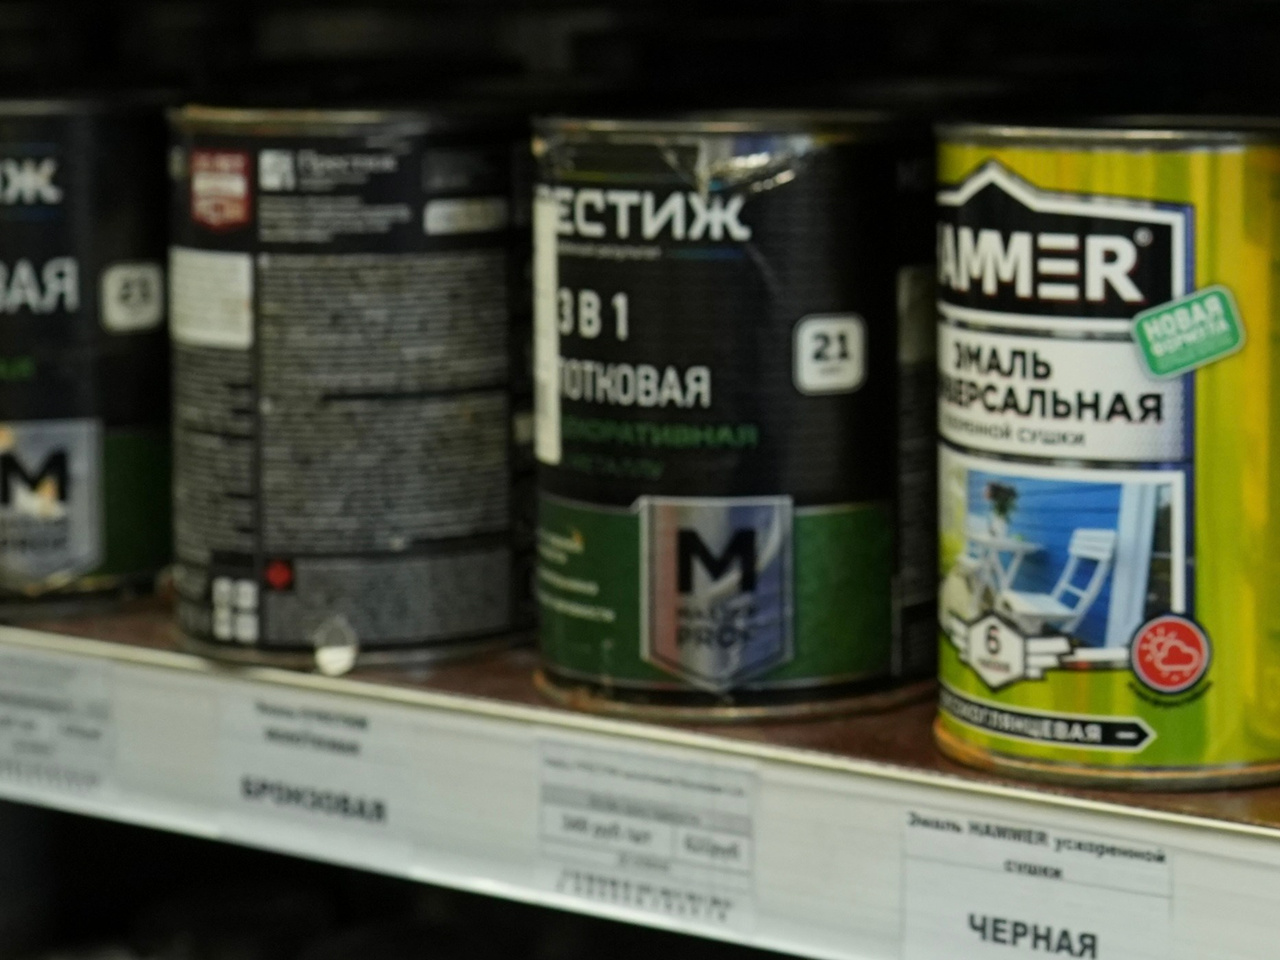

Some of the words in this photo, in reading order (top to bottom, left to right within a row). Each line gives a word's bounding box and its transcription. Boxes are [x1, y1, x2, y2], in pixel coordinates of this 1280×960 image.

[537, 187, 752, 242] ЕСТИЖ
[578, 289, 601, 340] В
[611, 291, 630, 342] 1
[1141, 295, 1224, 342] НОВАЯ
[812, 332, 851, 362] 21
[984, 625, 1003, 656] 6
[968, 820, 1050, 846] HAMMER
[1053, 837, 1167, 864] ускоренной
[967, 912, 1099, 960] ЧЕРНАЯ
